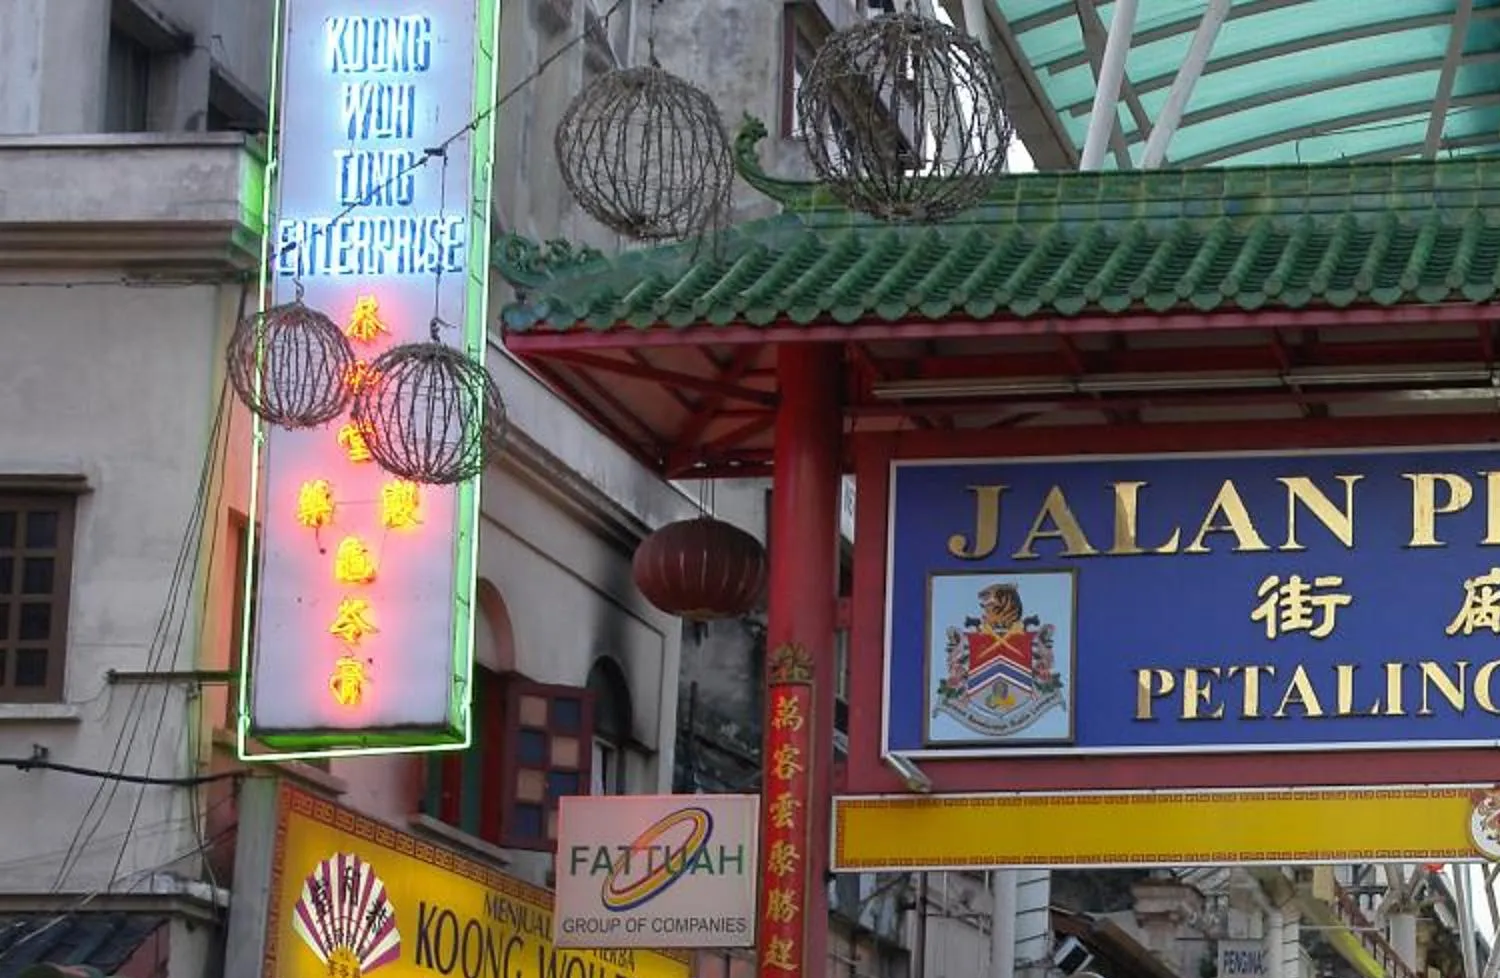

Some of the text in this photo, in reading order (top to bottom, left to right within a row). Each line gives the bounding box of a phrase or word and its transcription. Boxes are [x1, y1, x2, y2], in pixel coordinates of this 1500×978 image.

[325, 15, 432, 74] KOONG
[339, 79, 416, 141] WOH
[334, 149, 416, 207] TONG
[276, 213, 465, 277] ENTERPRISE
[948, 474, 1365, 560] JALAN
[570, 844, 744, 877] FATTUAH
[562, 916, 747, 934] GROUP OF COMPANIES
